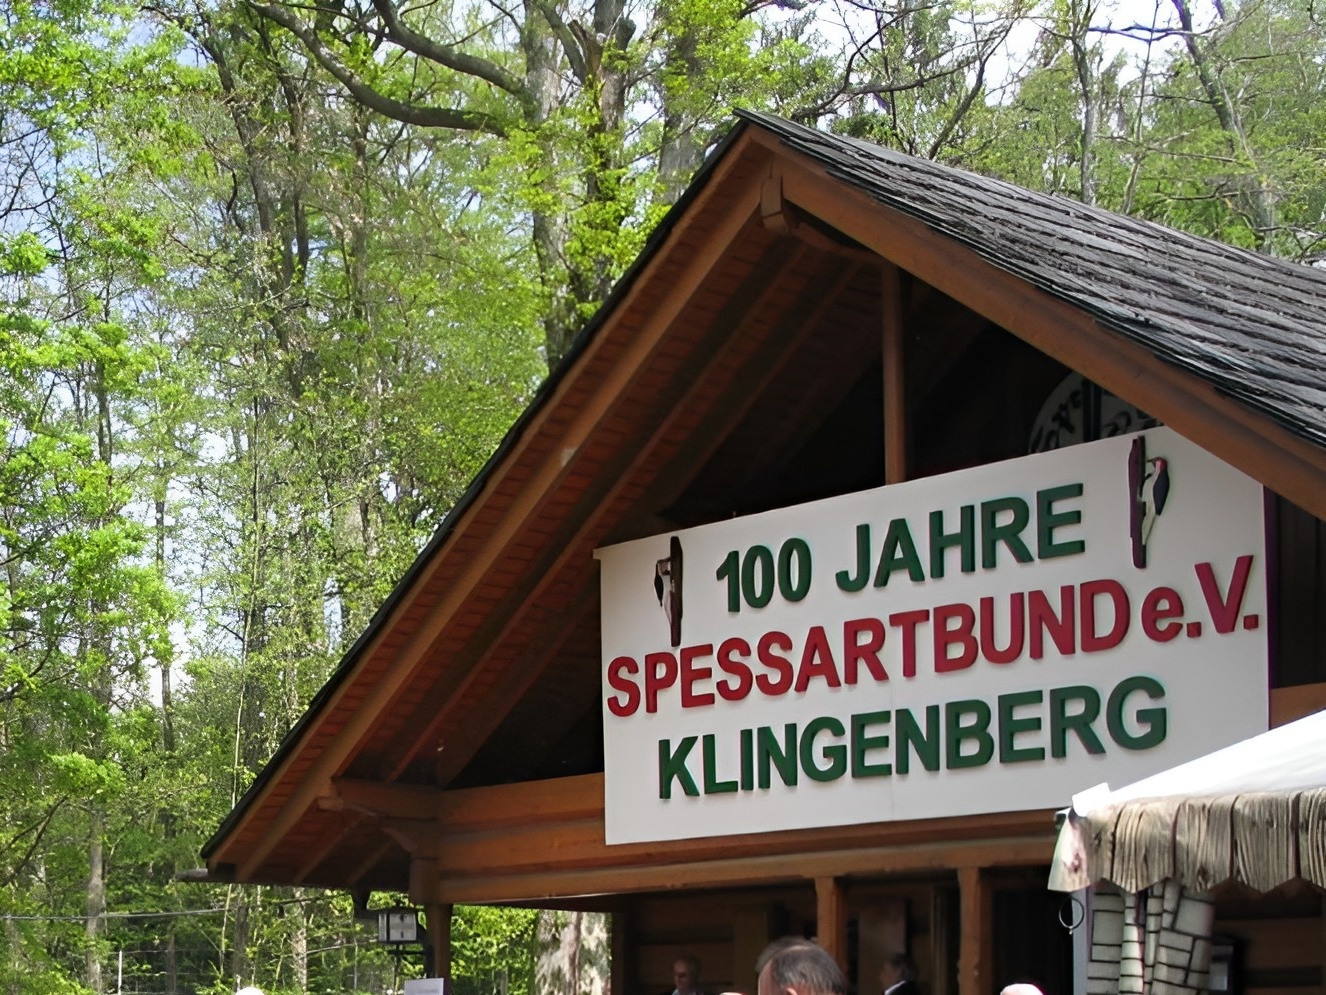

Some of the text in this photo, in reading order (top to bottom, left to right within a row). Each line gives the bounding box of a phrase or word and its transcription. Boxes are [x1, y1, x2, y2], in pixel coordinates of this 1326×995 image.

[716, 483, 1085, 613] 100 JAHRE
[607, 555, 1259, 717] SPESSARTBUND e.V.
[658, 675, 1168, 800] KLINGENBERG
